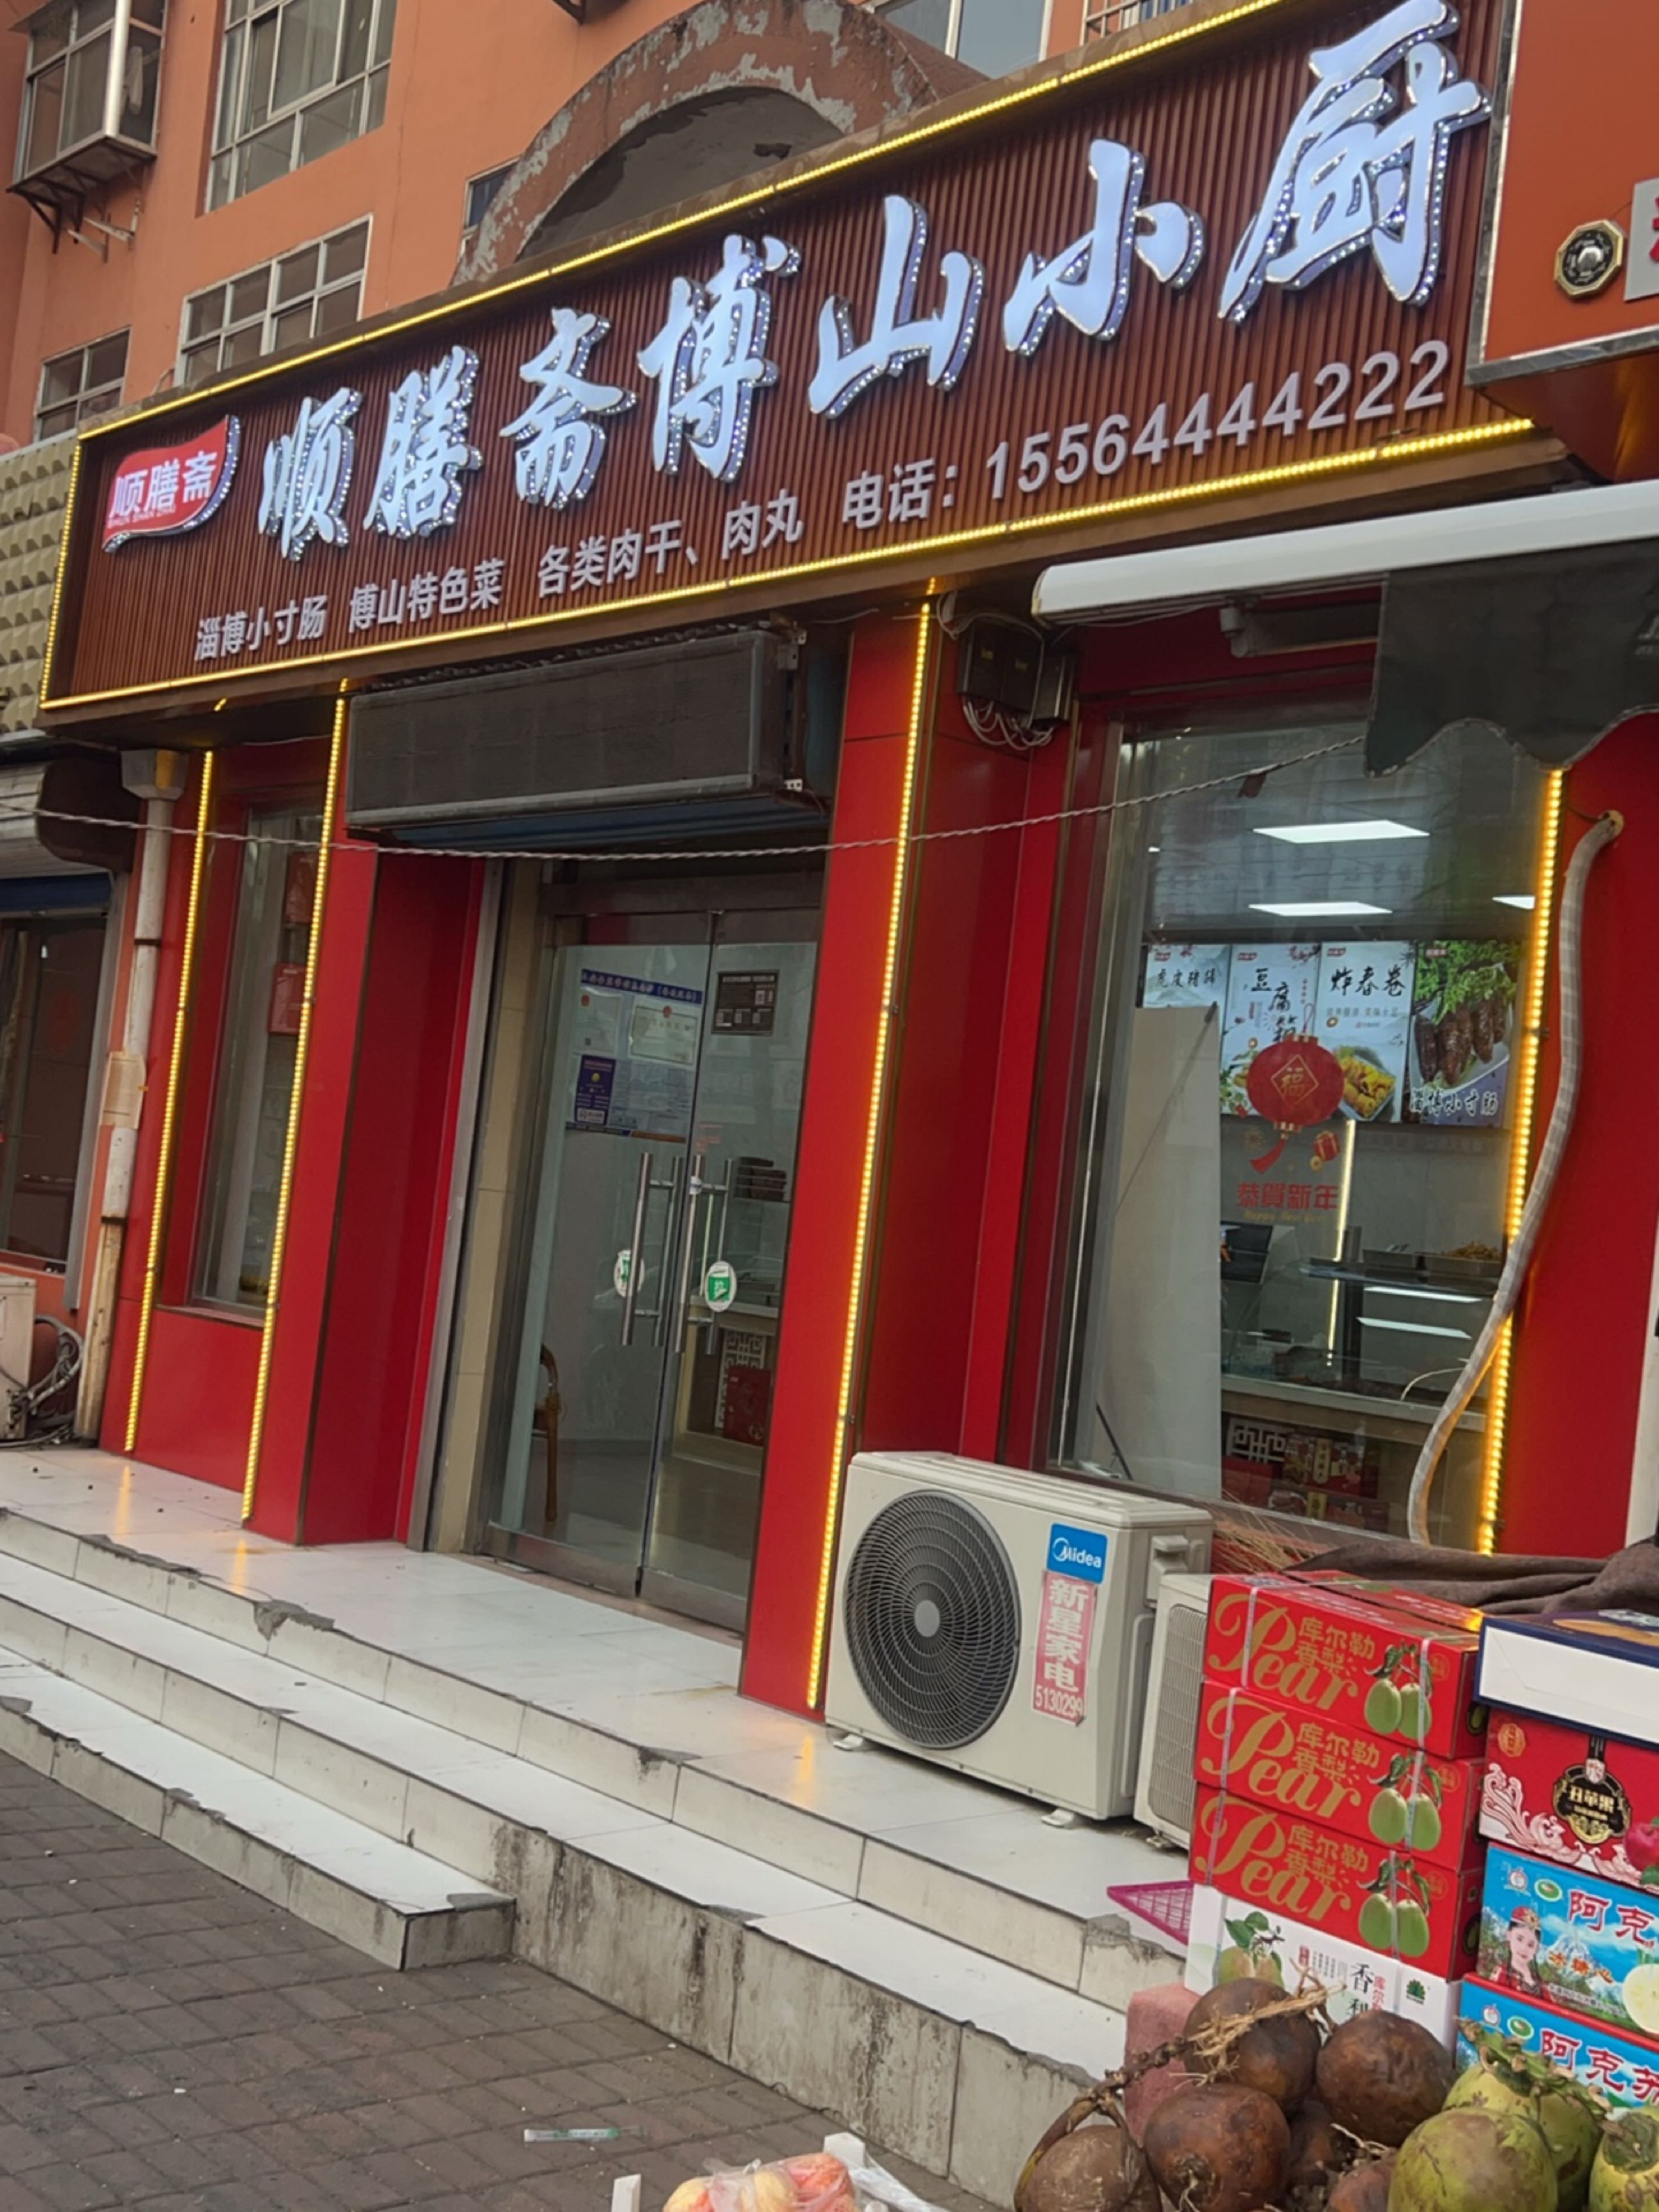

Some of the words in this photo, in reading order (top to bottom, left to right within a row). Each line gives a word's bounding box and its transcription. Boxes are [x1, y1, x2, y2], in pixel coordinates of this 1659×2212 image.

[109, 451, 217, 520] 顺膳斋
[195, 595, 328, 661] 淄博小寸肠
[349, 558, 504, 633] 博山特色菜
[538, 489, 804, 598] 各类肉干、肉丸
[1331, 965, 1406, 997] 炸春卷
[1237, 1183, 1339, 1210] 恭賀新年
[1052, 1537, 1102, 1569] Midea
[1210, 1593, 1359, 1710] Pear
[1295, 1640, 1347, 1678] 香梨
[1299, 1616, 1376, 1660] 库尔勒
[1201, 1697, 1362, 1818] Pear
[1292, 1746, 1347, 1783] 香梨
[1296, 1722, 1381, 1768] 库尔勒
[1194, 1795, 1352, 1921] Pear
[1284, 1847, 1338, 1887] 香梨
[1288, 1824, 1369, 1873] 库尔勒
[1568, 1889, 1656, 1948] 阿克
[1372, 1975, 1386, 2010] 库尔
